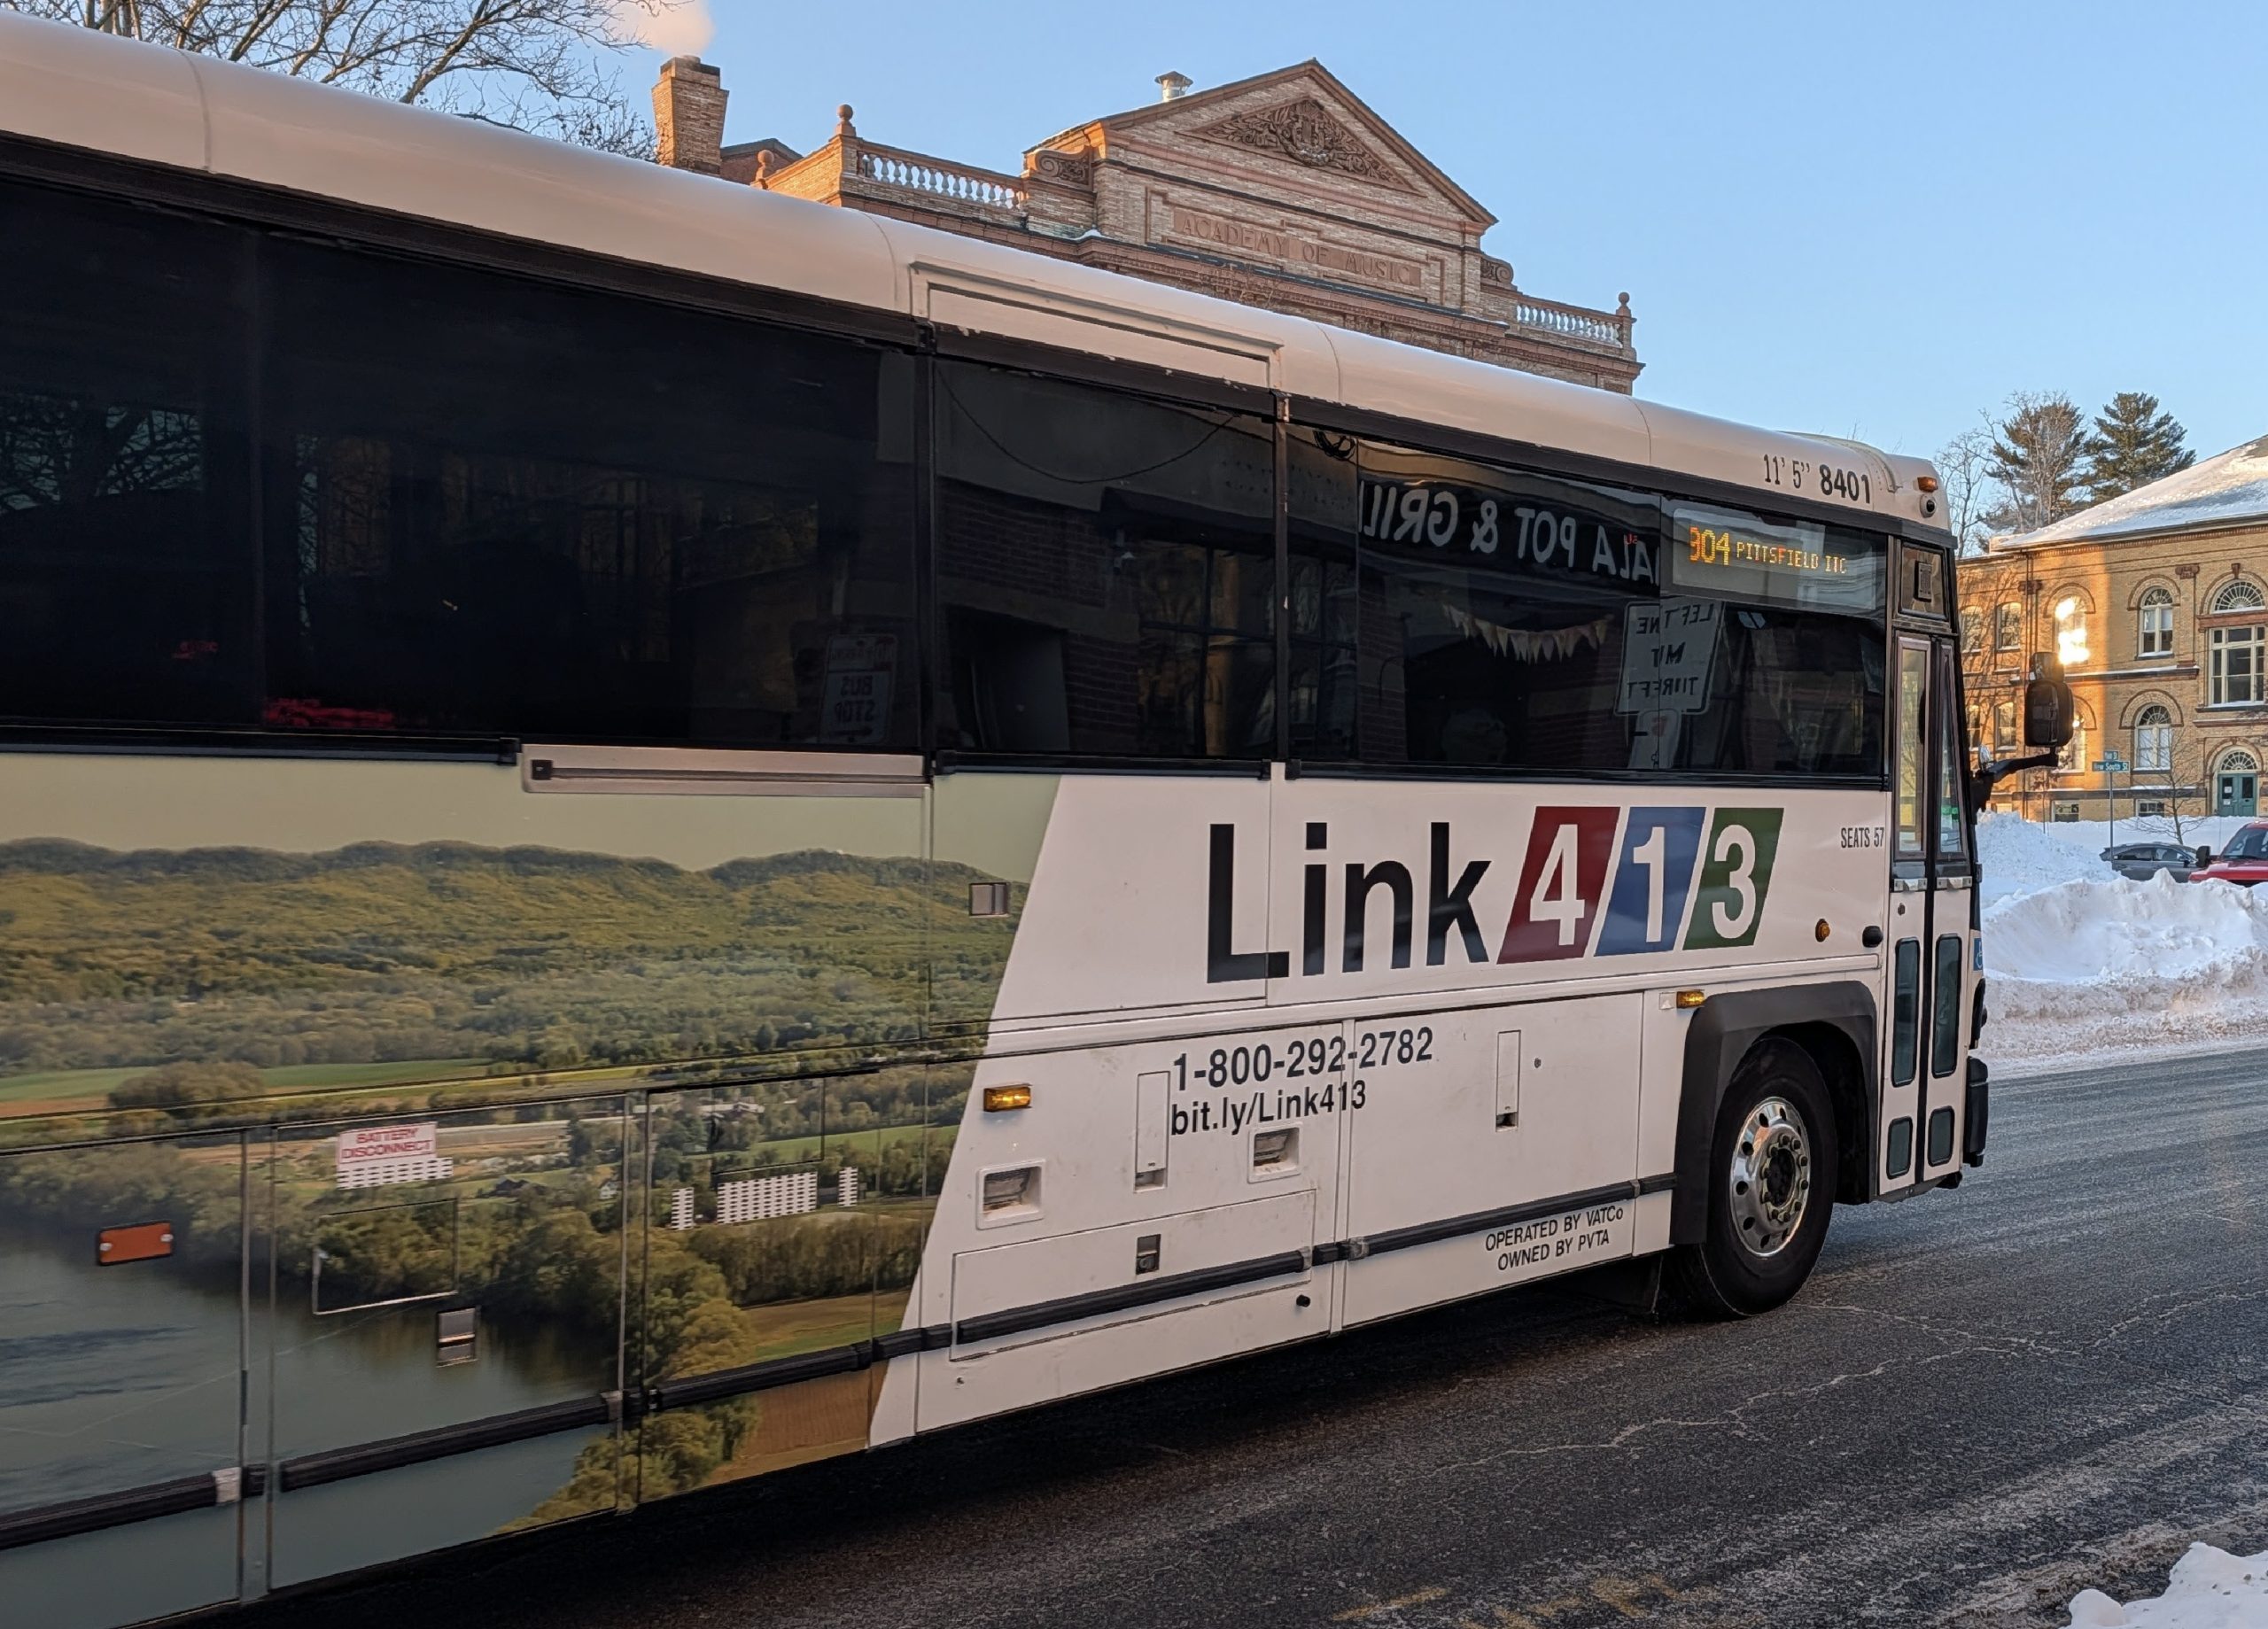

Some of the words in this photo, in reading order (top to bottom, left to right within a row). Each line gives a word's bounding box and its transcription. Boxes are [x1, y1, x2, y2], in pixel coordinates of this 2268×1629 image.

[1183, 218, 1286, 257] ACADEMY
[1303, 244, 1328, 263] OF
[1345, 252, 1413, 285] MUSIC
[1819, 464, 1871, 504] 8401
[1689, 526, 1730, 566] 304
[1736, 541, 1819, 569] PITTSFIELD
[1841, 827, 1870, 849] SEATS
[1874, 826, 1885, 848] 57
[1173, 1026, 1433, 1091] 1-800-292-2782
[1170, 1079, 1367, 1136] bit.ly/Link413
[340, 1139, 433, 1160] DISCONNECT
[356, 1127, 419, 1144] BATTERY
[1485, 1219, 1558, 1252] OPERATED
[1564, 1213, 1581, 1234] BY
[1586, 1205, 1624, 1227] VATCo
[1498, 1243, 1550, 1271] OWNED
[1555, 1237, 1573, 1258] BY
[1578, 1229, 1610, 1252] PVTA
